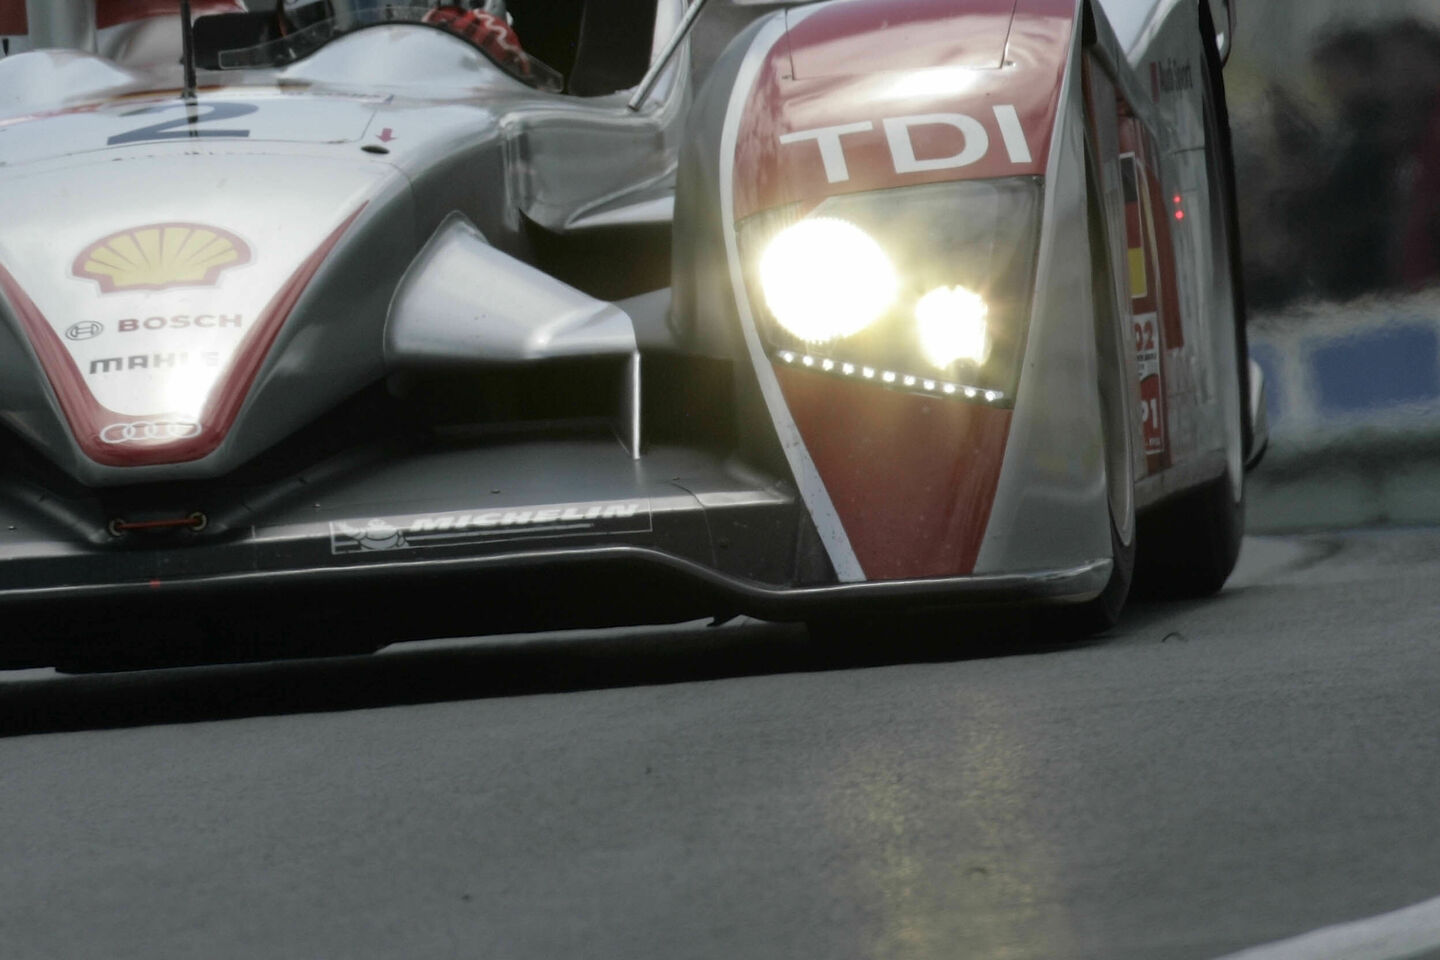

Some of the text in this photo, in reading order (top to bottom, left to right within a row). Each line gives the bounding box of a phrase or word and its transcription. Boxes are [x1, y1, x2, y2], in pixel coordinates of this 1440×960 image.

[107, 102, 259, 145] 2
[779, 104, 1032, 183] TDI
[118, 314, 243, 332] BOSCH
[411, 504, 638, 531] MICHELIN
